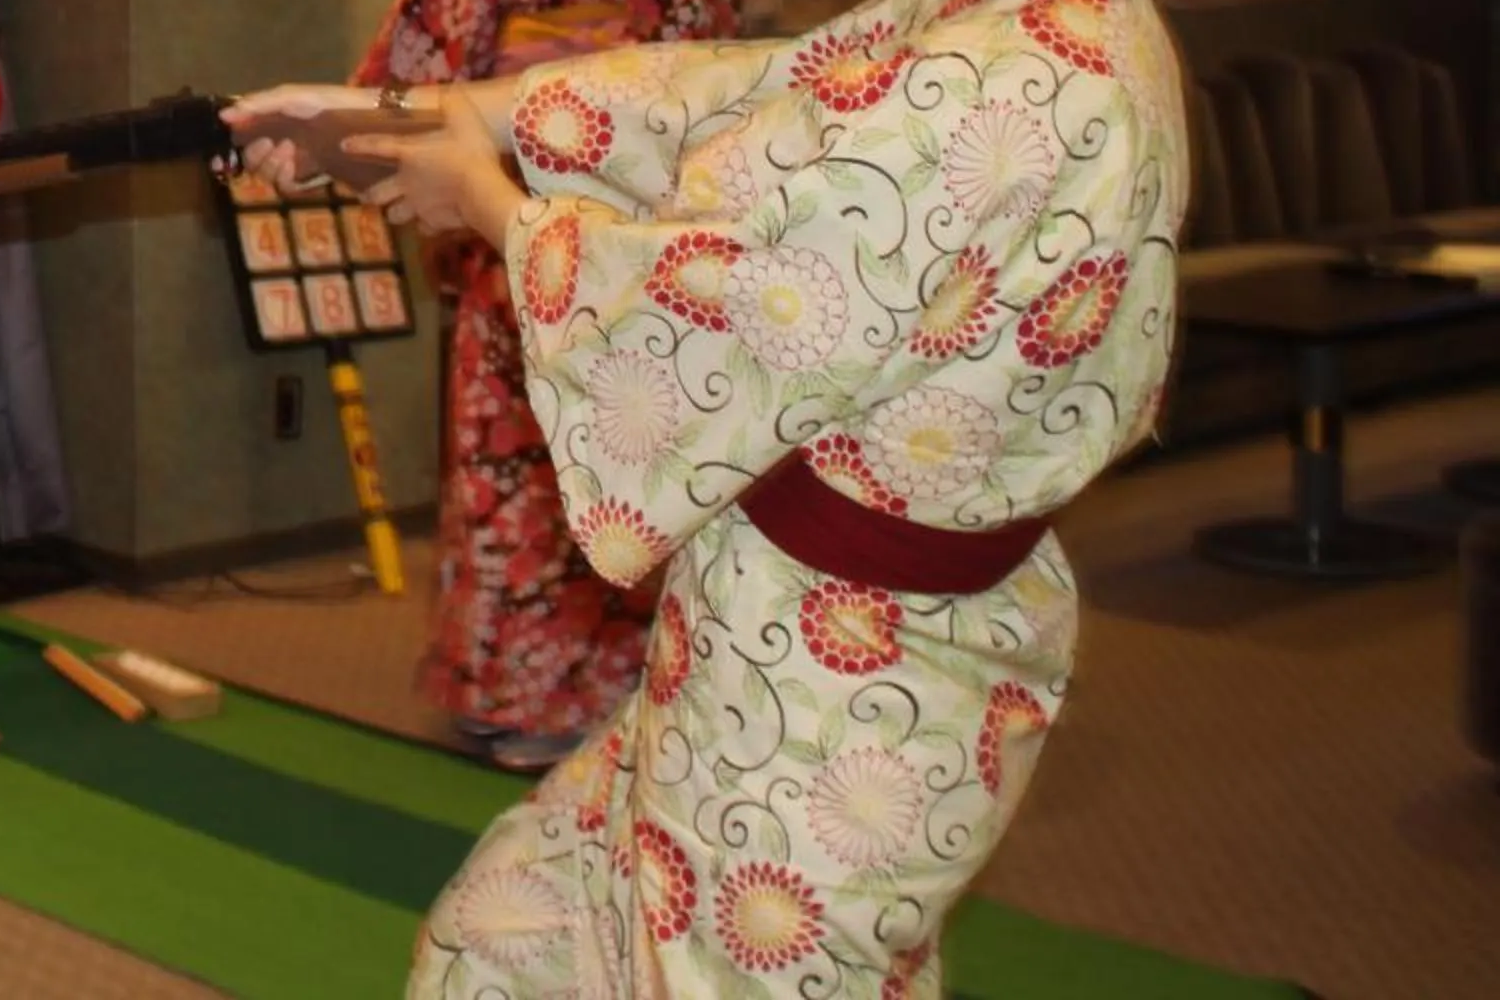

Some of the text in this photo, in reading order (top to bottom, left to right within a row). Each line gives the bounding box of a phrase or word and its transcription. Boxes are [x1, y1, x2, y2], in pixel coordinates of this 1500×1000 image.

[257, 218, 279, 258] 4
[304, 214, 330, 262] 5
[266, 274, 395, 334] 7 8 9
